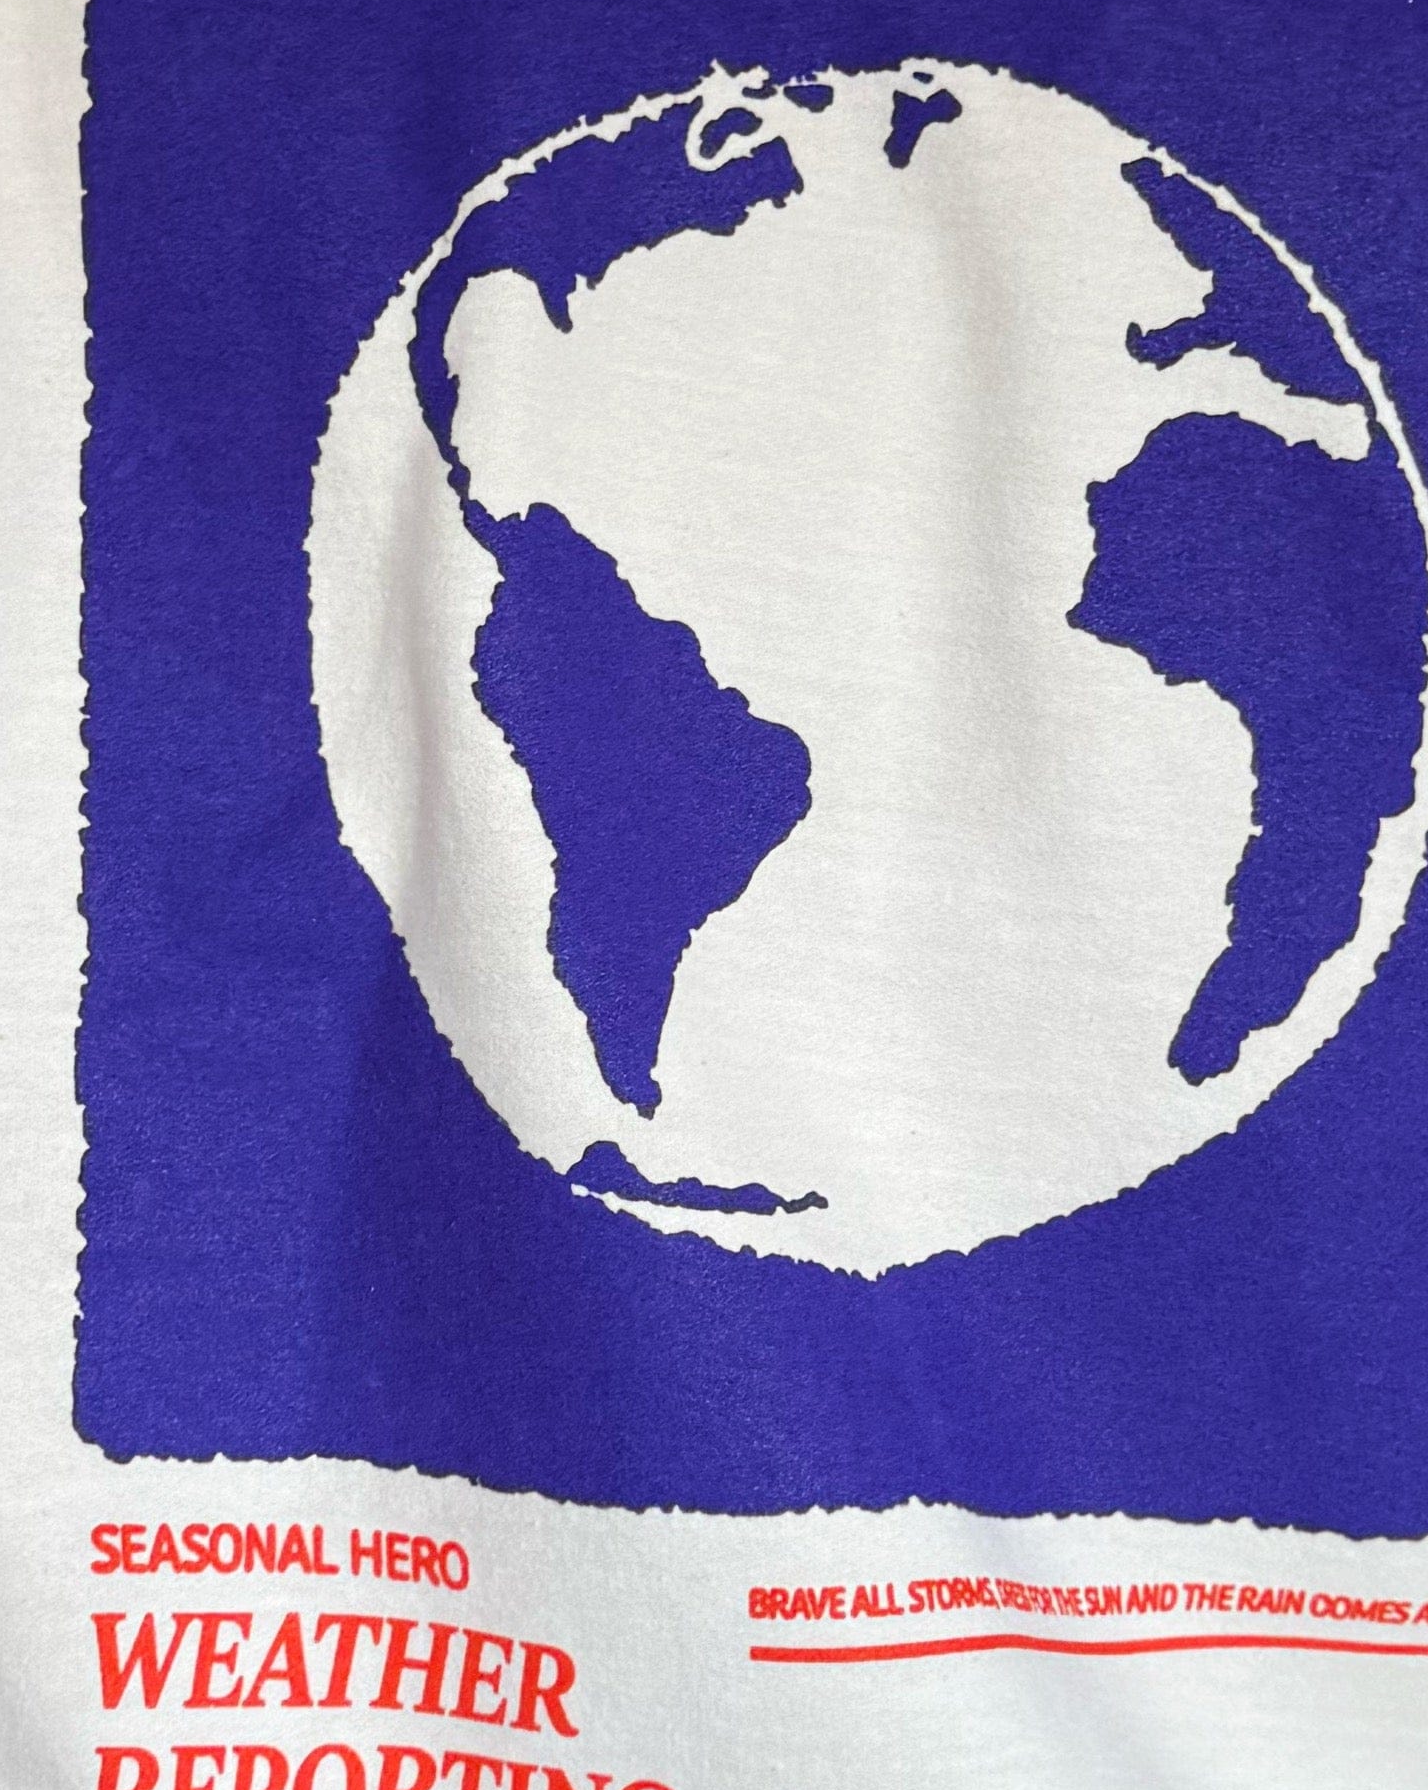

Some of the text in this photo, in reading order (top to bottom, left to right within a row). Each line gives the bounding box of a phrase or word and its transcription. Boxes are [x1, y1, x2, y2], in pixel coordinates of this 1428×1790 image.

[89, 1522, 471, 1592] SEASONAL HERO
[748, 1586, 847, 1620] BRAVE
[850, 1582, 905, 1618] ALL
[1052, 1586, 1085, 1616] THE
[1084, 1585, 1123, 1616] SUN
[1125, 1582, 1179, 1614] AND
[1183, 1582, 1234, 1612] THE
[1237, 1585, 1305, 1615] RAIN
[1308, 1591, 1412, 1625] COMES
[90, 1611, 579, 1738] WEATHER
